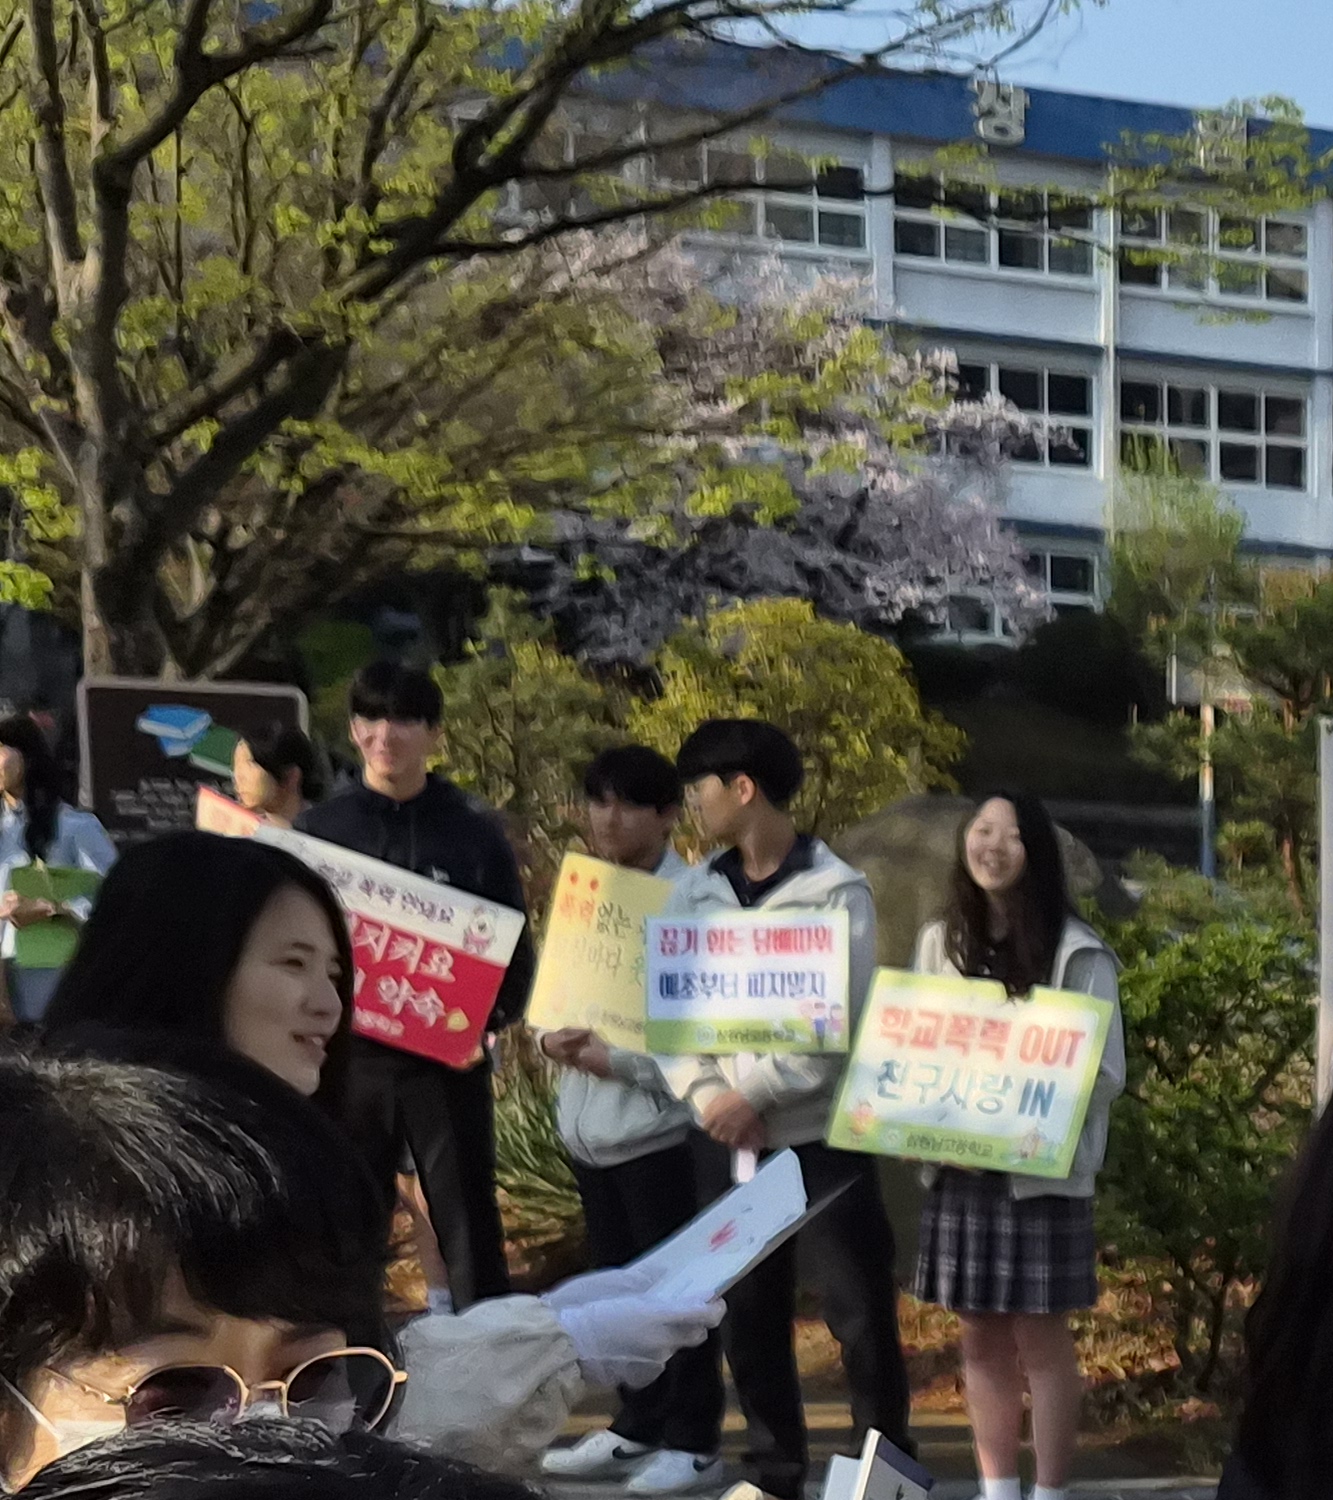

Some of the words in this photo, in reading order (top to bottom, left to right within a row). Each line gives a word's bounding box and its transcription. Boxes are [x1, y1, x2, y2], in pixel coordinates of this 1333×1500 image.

[880, 1006, 1013, 1061] 학교폭력
[1018, 1023, 1087, 1069] OUT
[876, 1058, 1014, 1115] 친구사랑
[1017, 1077, 1057, 1119] IN
